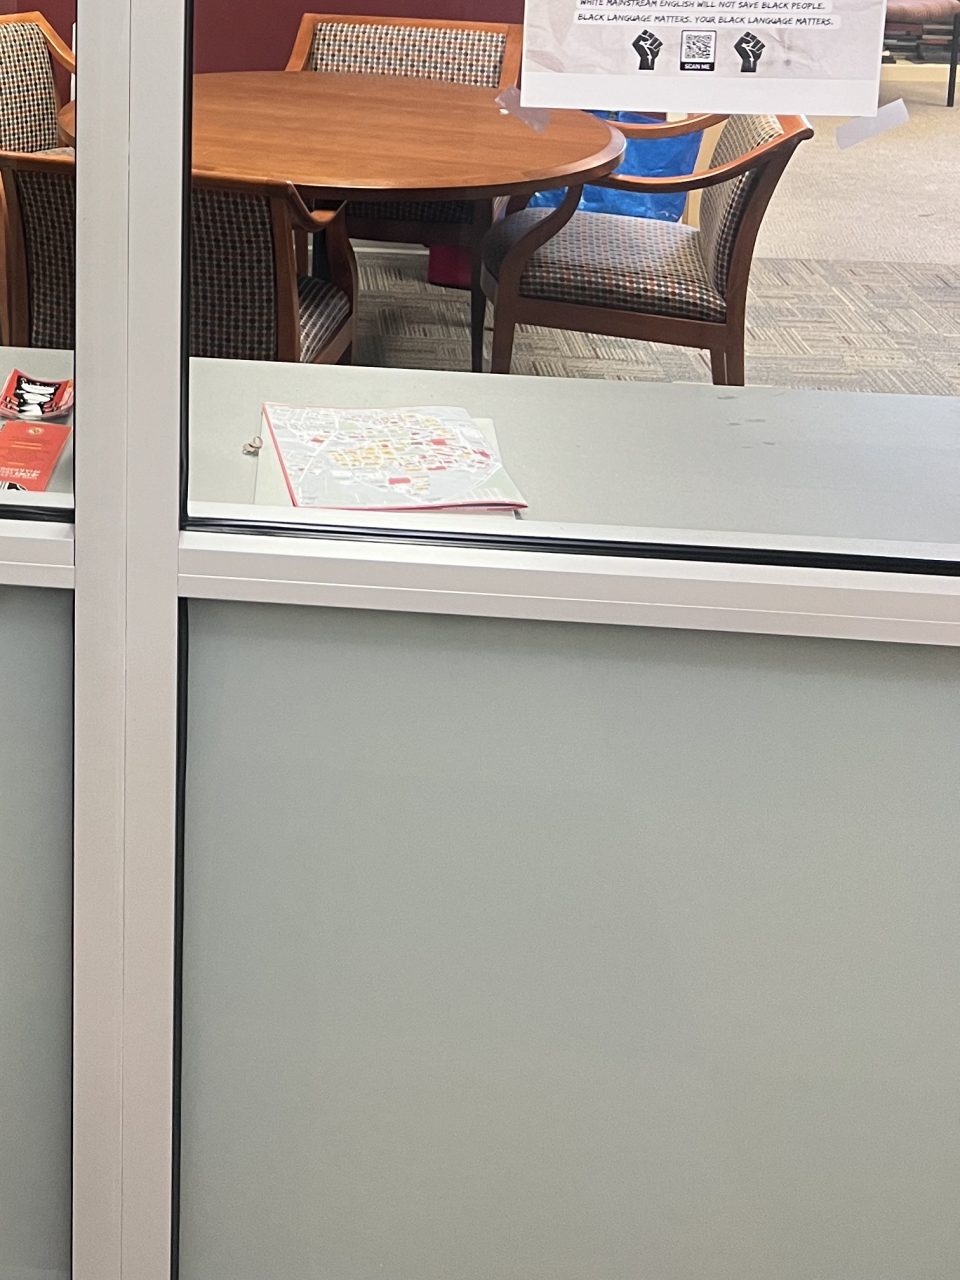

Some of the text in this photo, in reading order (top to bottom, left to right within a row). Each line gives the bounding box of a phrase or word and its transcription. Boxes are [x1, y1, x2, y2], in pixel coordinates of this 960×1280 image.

[578, 13, 604, 21] BLACK
[607, 14, 651, 22] LANGUAGE
[718, 16, 745, 24] BLACK
